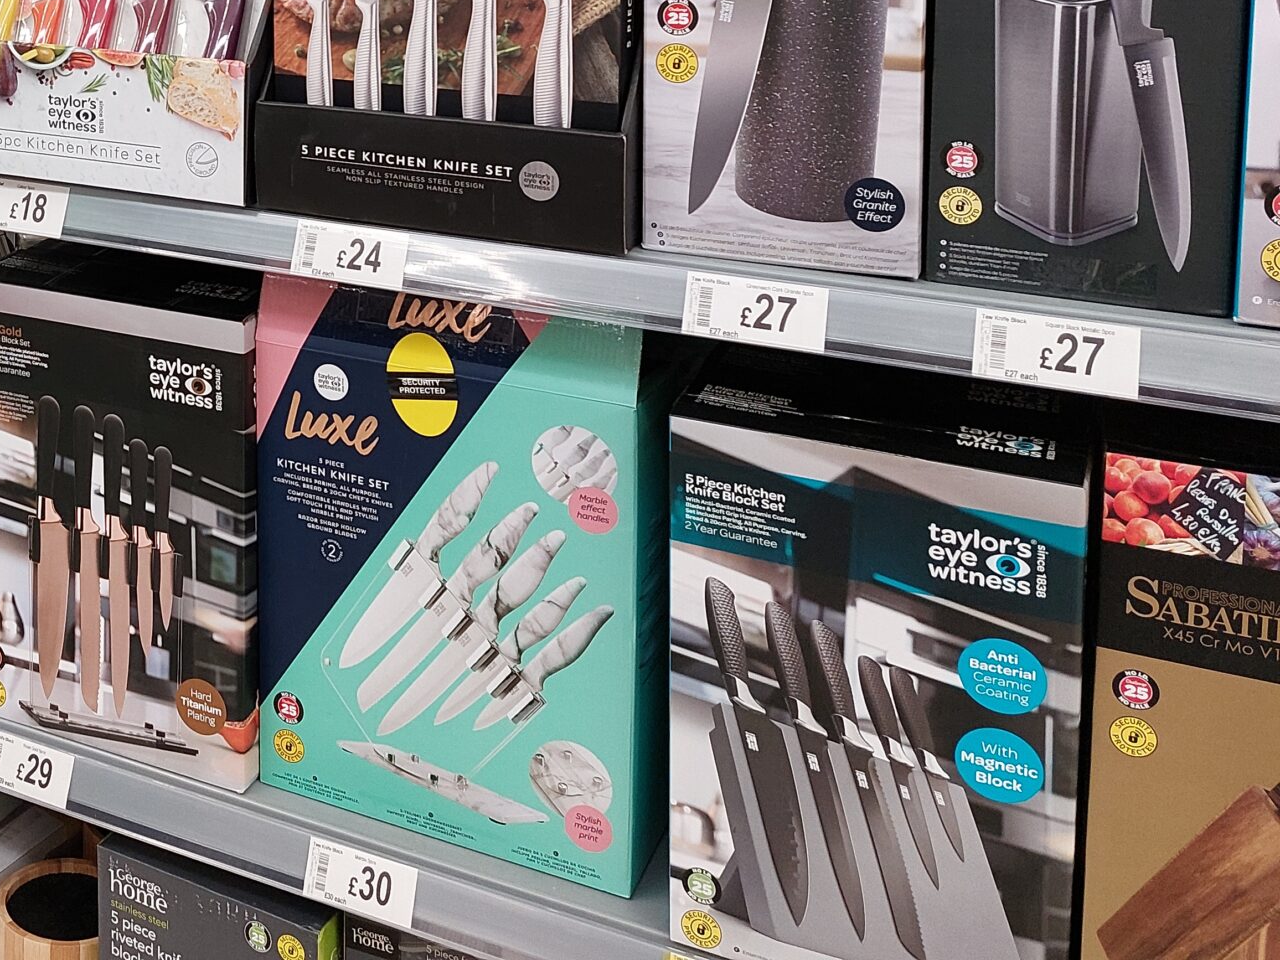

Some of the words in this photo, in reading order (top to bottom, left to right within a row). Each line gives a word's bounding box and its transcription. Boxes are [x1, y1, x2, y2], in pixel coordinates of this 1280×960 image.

[48, 95, 97, 111] taylor's
[48, 110, 71, 119] eye
[48, 118, 97, 133] witness
[27, 137, 84, 156] Kitchen
[90, 144, 129, 161] Knife
[135, 150, 161, 164] Set
[302, 145, 308, 154] 5
[315, 147, 355, 160] PIECE
[362, 152, 426, 168] KITCHEN
[434, 159, 478, 173] KNIFE
[485, 166, 513, 178] SET
[327, 166, 365, 176] SEAMLESS
[368, 170, 381, 178] ALL
[384, 173, 425, 183] STAINLESS
[428, 177, 452, 186] STEEL
[454, 180, 484, 189] DESIGN
[346, 175, 362, 183] NON
[384, 180, 424, 191] TEXTURED
[427, 185, 463, 195] HANDLES
[856, 188, 893, 200] Stylish
[10, 192, 47, 222] £18
[853, 200, 896, 213] Granite
[857, 211, 892, 224] Effect
[337, 239, 381, 273] £24
[740, 294, 797, 332] £27
[723, 330, 738, 338] each
[1040, 333, 1104, 375] £27
[399, 386, 446, 395] PROTECTED
[402, 377, 440, 387] SECURITY
[284, 391, 380, 456] Luxe
[277, 458, 325, 476] KITCHEN
[331, 470, 364, 485] KNIFE
[369, 479, 389, 490] SET
[686, 474, 693, 483] 5
[696, 476, 731, 491] Piece
[734, 483, 785, 502] Kitchen
[686, 484, 720, 499] Knife
[723, 492, 758, 507] Block
[761, 499, 784, 513] Set
[579, 494, 608, 506] Marble
[581, 504, 606, 515] effect
[576, 513, 610, 524] handles
[929, 522, 1032, 558] taylor's
[929, 545, 977, 569] eye
[929, 563, 1031, 596] witness
[1163, 627, 1193, 643] X45
[1199, 635, 1219, 648] Cr
[1225, 641, 1253, 656] Mo
[988, 649, 1018, 665] Anti
[970, 658, 1037, 682] Bacterial
[973, 672, 1032, 693] Ceramic
[181, 695, 222, 716] Titanium
[191, 688, 212, 702] Hard
[975, 685, 1030, 707] Coating
[187, 709, 216, 728] Plating
[982, 742, 1018, 759] With
[17, 753, 52, 788] £29
[961, 751, 1039, 779] Magnetic
[975, 771, 1022, 793] Block
[574, 821, 603, 837] marble
[575, 812, 602, 827] Stylish
[579, 832, 598, 844] print
[109, 868, 167, 914] home
[348, 867, 391, 906] £30
[111, 899, 146, 921] stainless
[148, 914, 168, 929] steel
[112, 931, 154, 955] riveted
